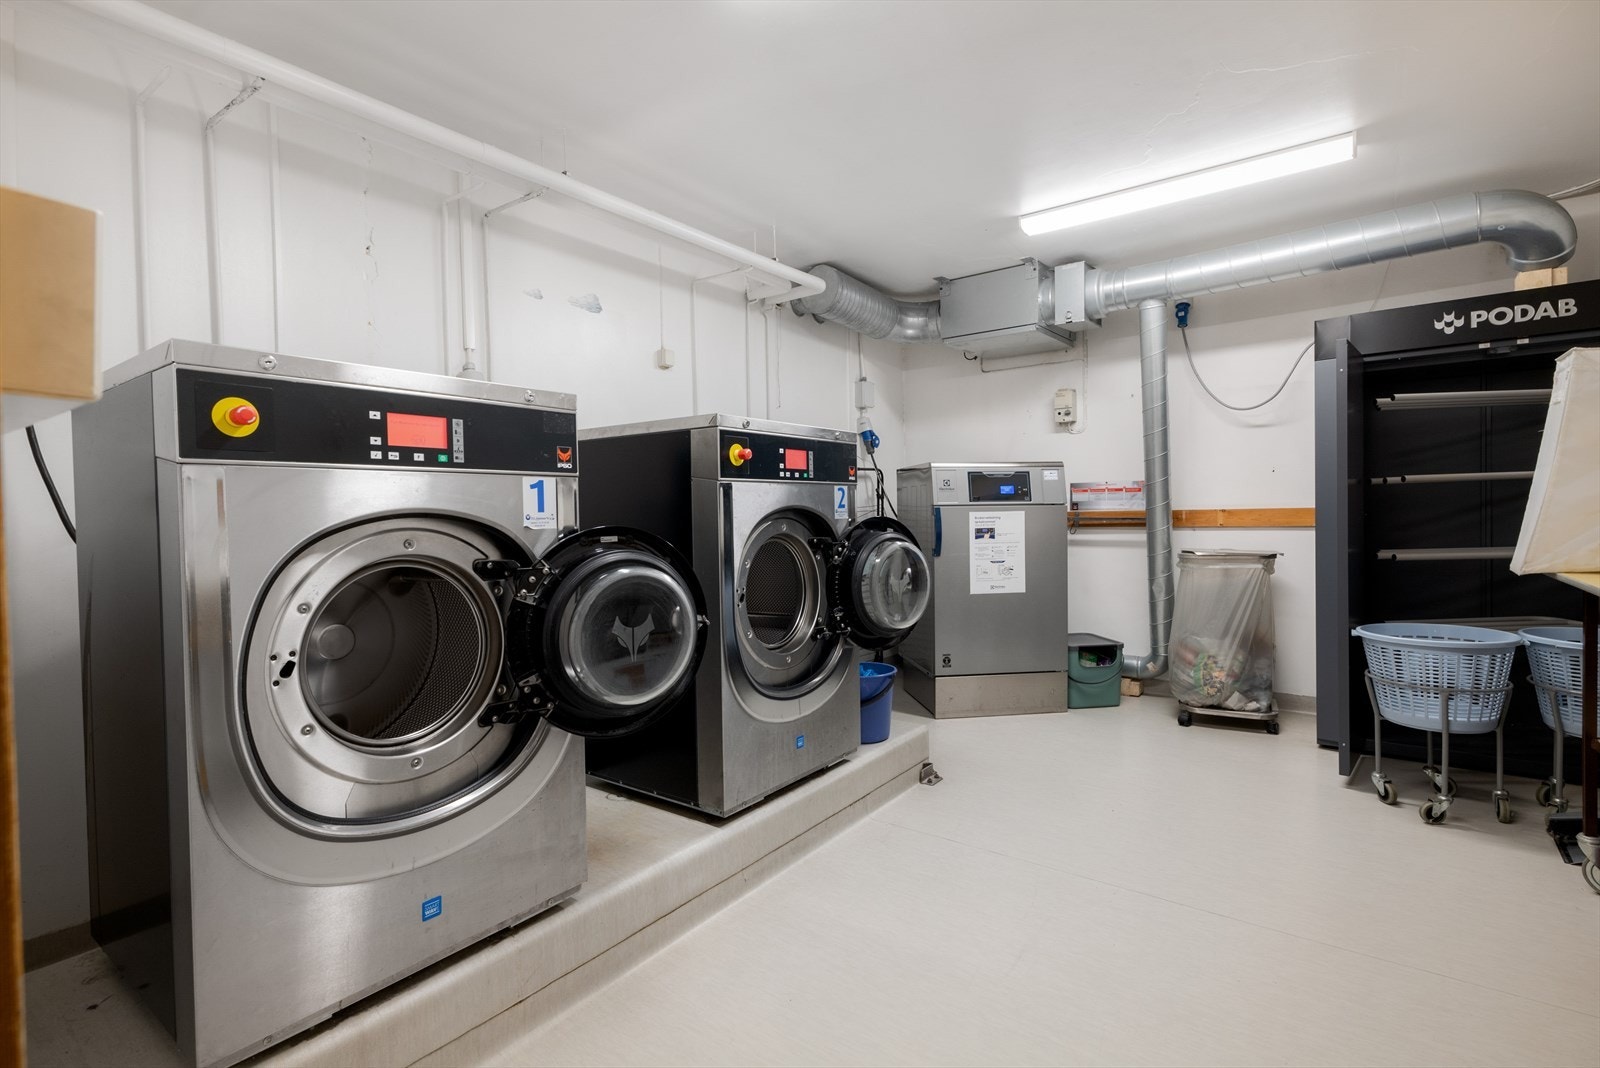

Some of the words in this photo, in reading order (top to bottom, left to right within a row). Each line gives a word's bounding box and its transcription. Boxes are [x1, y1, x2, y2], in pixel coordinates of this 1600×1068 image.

[1470, 298, 1578, 328] PODAB
[529, 479, 545, 513] 1
[837, 487, 846, 509] 2
